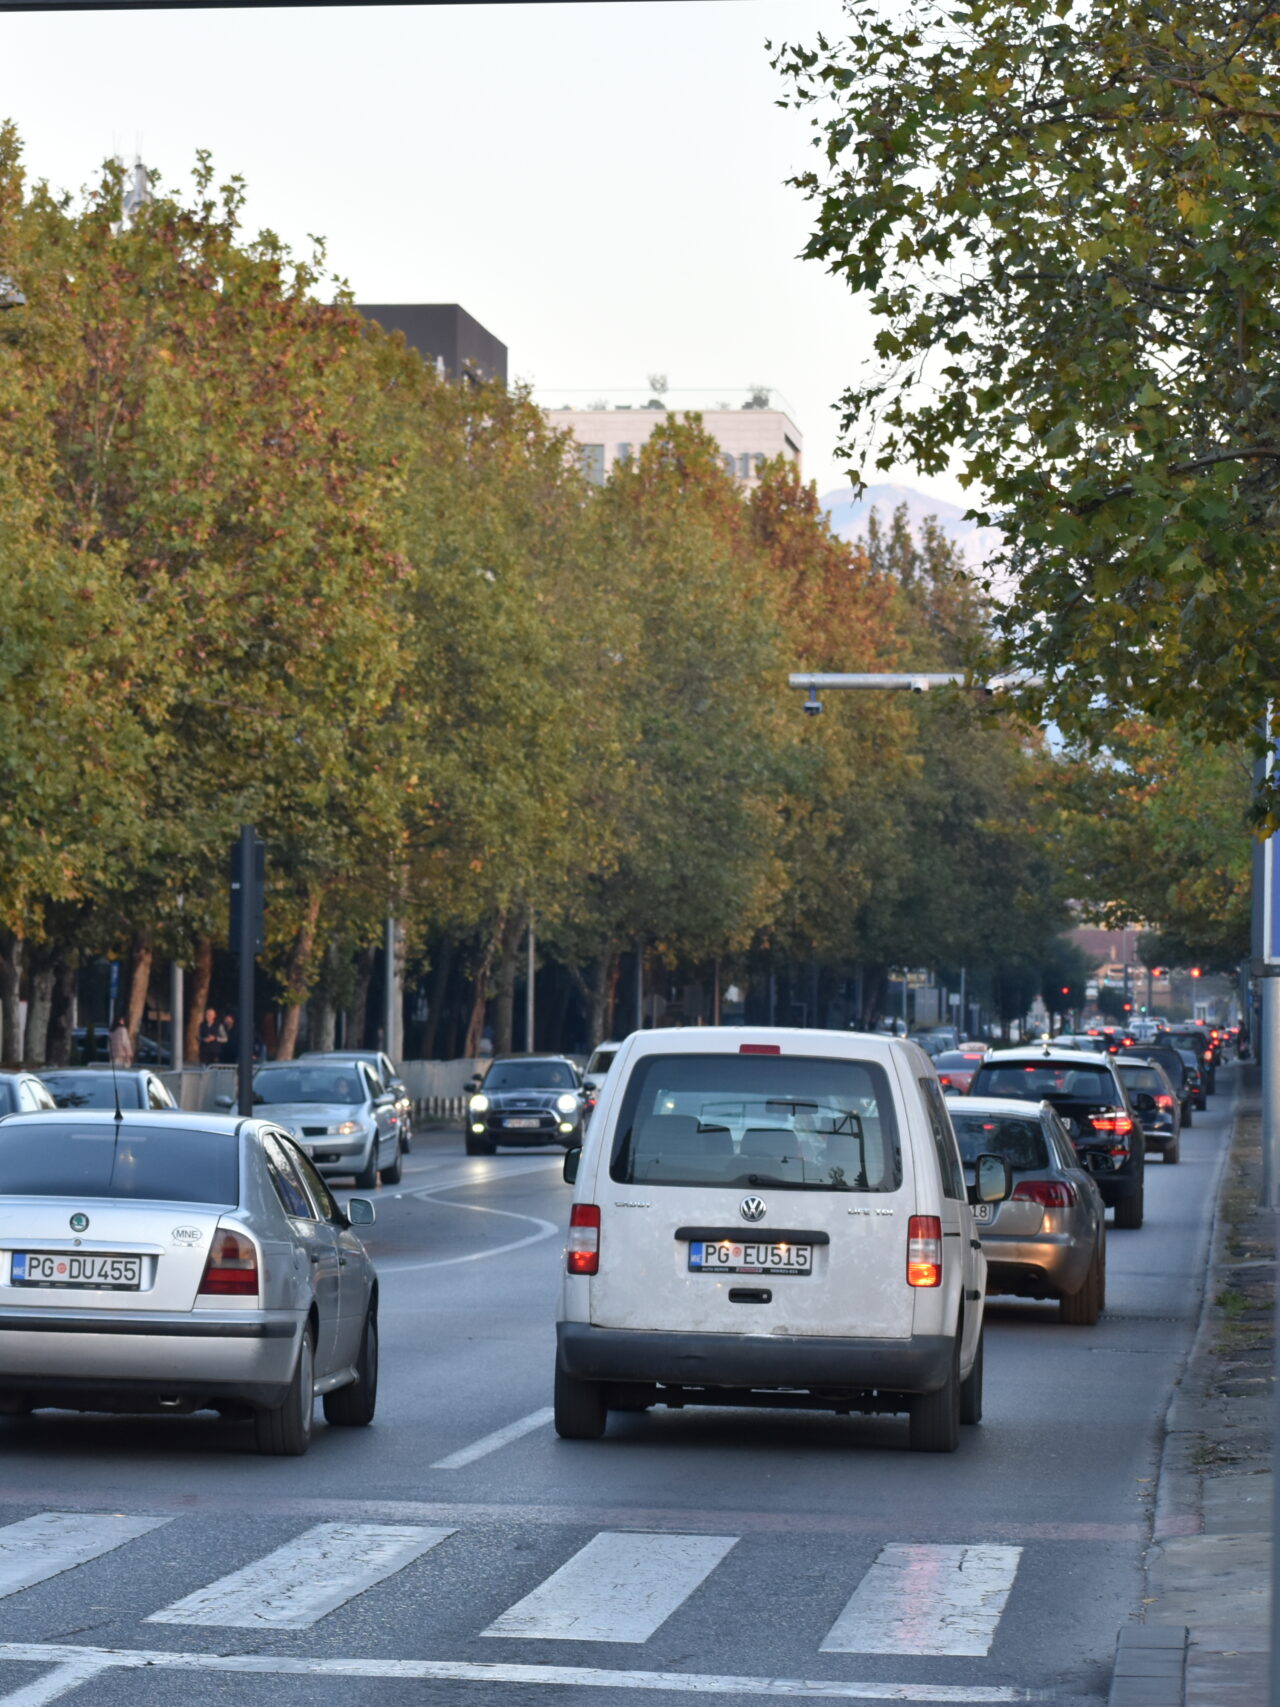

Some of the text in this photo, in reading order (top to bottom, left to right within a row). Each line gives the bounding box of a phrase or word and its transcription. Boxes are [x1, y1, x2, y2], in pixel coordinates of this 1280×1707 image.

[176, 1229, 199, 1239] MNE
[705, 1244, 808, 1266] PG EU515
[28, 1257, 137, 1281] PG DU455
